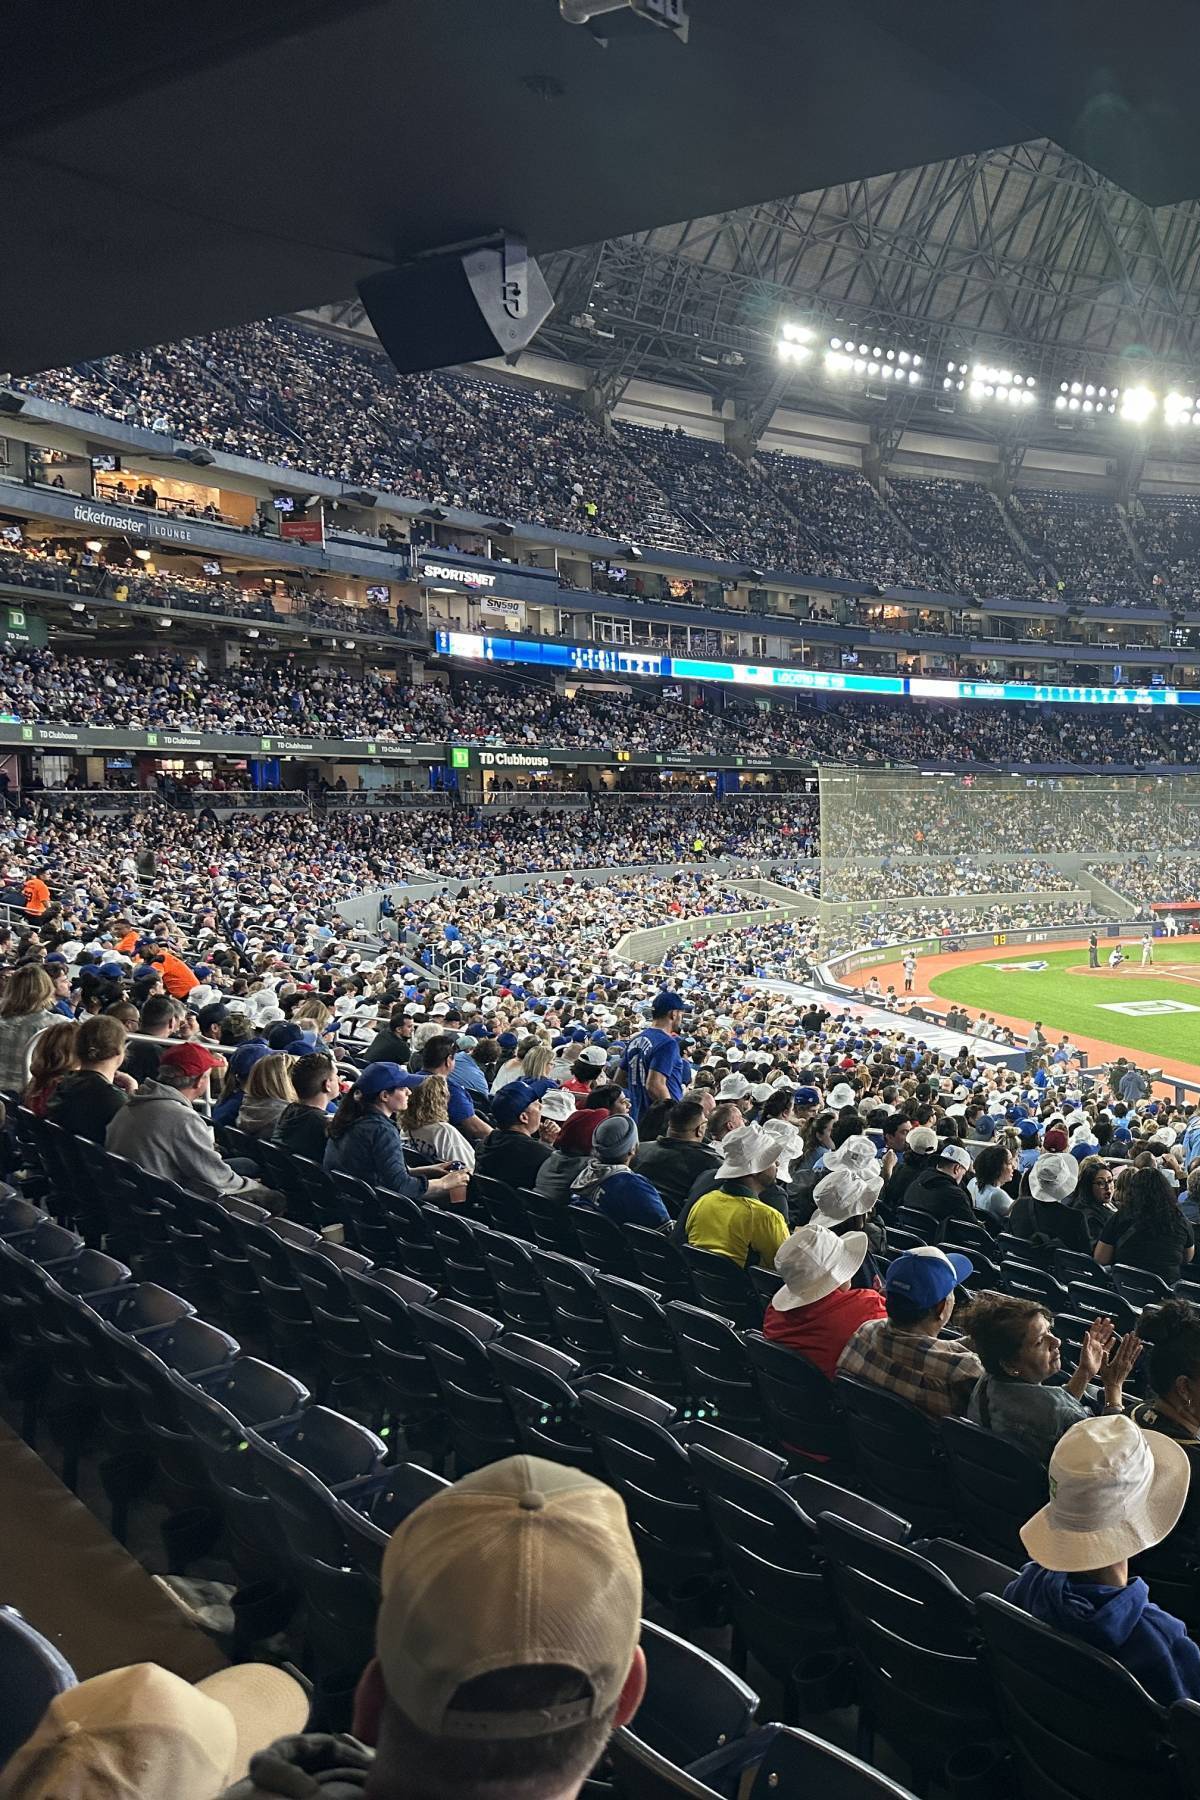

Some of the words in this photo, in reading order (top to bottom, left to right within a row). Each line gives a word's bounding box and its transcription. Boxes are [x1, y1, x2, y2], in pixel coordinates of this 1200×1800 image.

[74, 505, 144, 533] ticketmaster
[155, 526, 192, 541] LOUNGE
[424, 565, 496, 586] SPORTSNET
[486, 599, 519, 611] SN590
[40, 730, 48, 738] TD
[48, 731, 78, 740] Clubhouse
[164, 736, 172, 744] TD
[173, 737, 201, 745] Clubhouse
[479, 752, 495, 765] TD
[496, 753, 549, 766] Clubhouse
